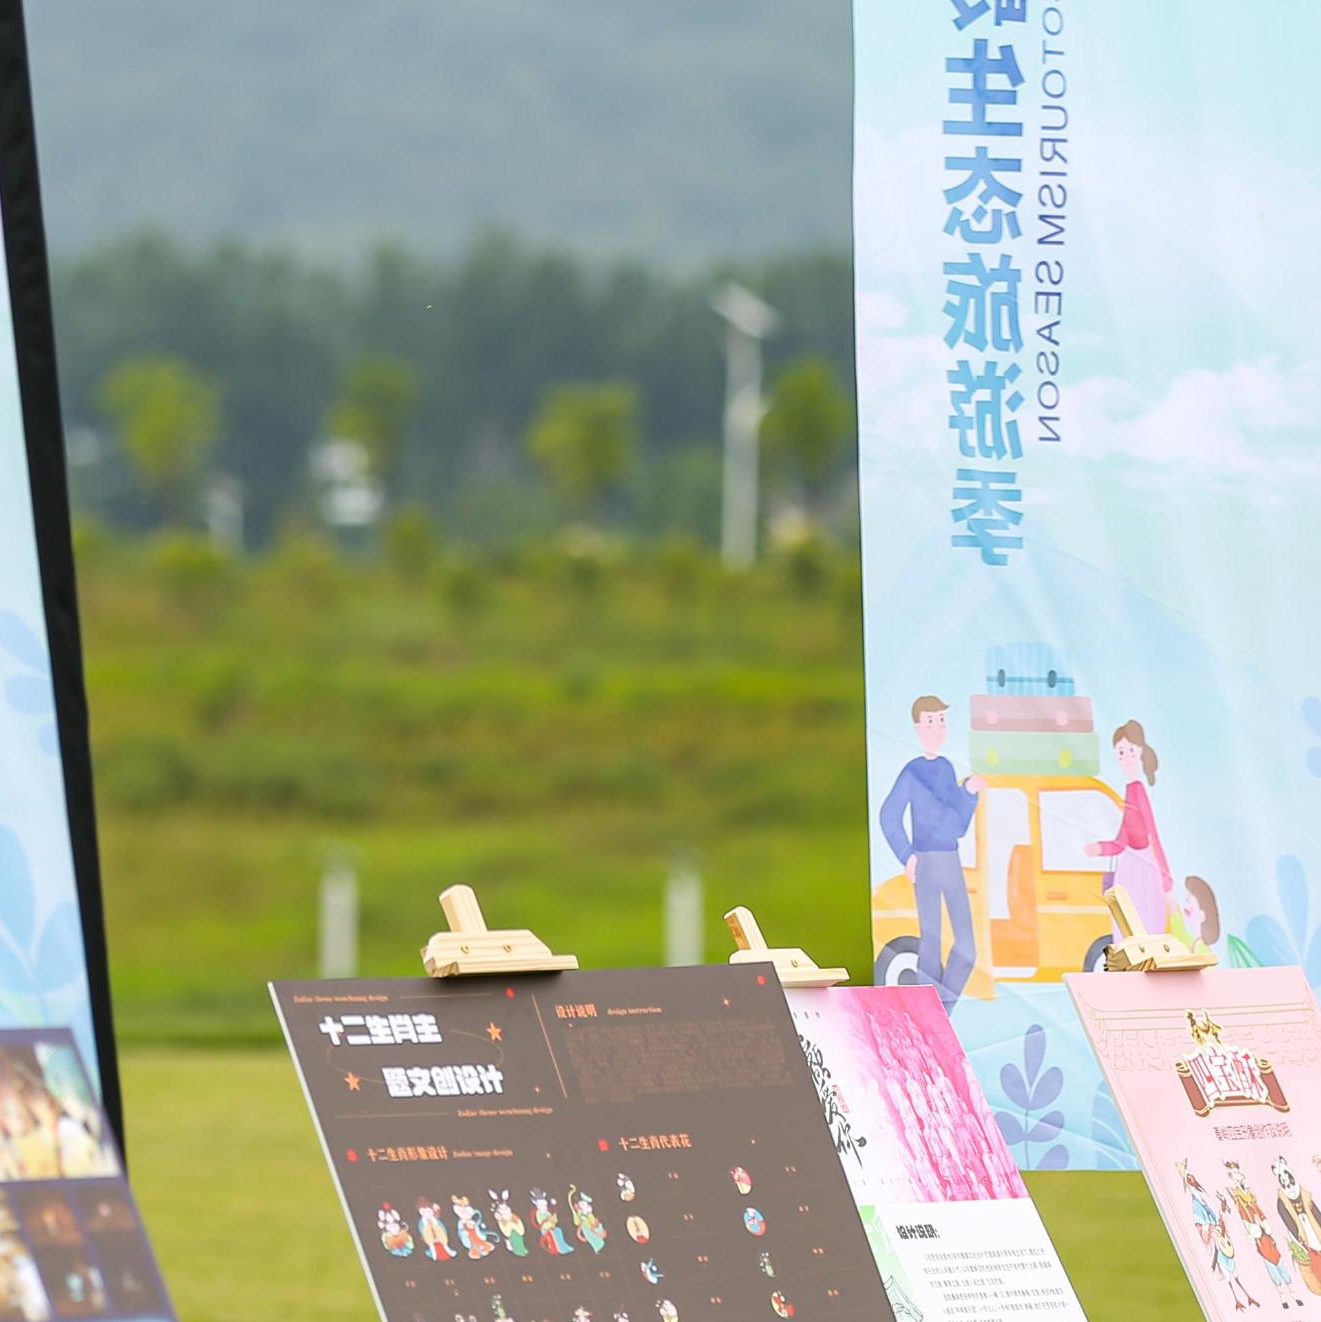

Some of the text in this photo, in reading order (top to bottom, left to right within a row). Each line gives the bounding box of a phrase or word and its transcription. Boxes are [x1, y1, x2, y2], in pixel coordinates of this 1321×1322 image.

[555, 1003, 598, 1019] 设计说明
[318, 1013, 443, 1046] 十二生肖主
[382, 1063, 504, 1098] 题文创设计
[618, 1132, 692, 1151] 十二生肖代表花
[367, 1144, 449, 1162] 十二生肖形象设计
